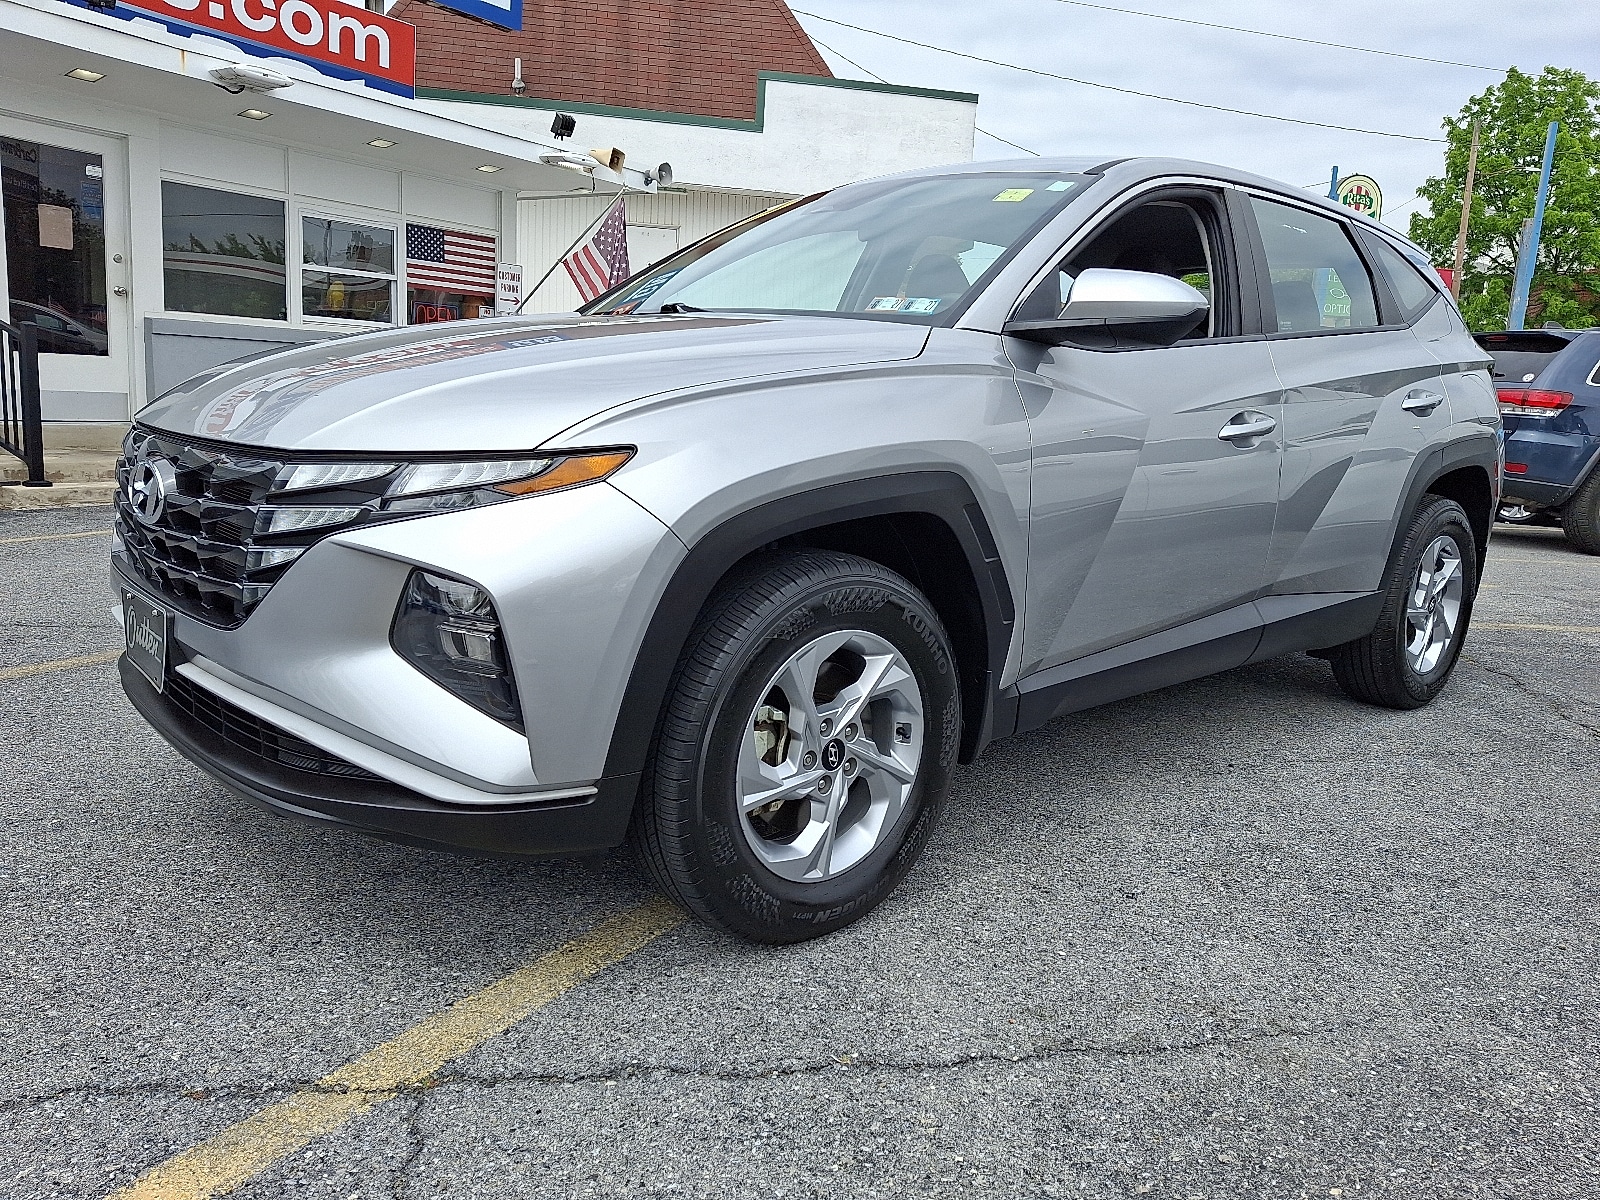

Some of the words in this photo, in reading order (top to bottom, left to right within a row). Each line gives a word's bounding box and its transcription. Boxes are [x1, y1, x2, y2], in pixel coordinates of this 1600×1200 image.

[163, 0, 390, 69] .com
[1346, 193, 1371, 206] Rita's
[499, 270, 521, 282] CUSTOMER
[500, 282, 519, 294] PARKING
[416, 305, 457, 323] OPEN
[901, 606, 948, 674] KUMHO
